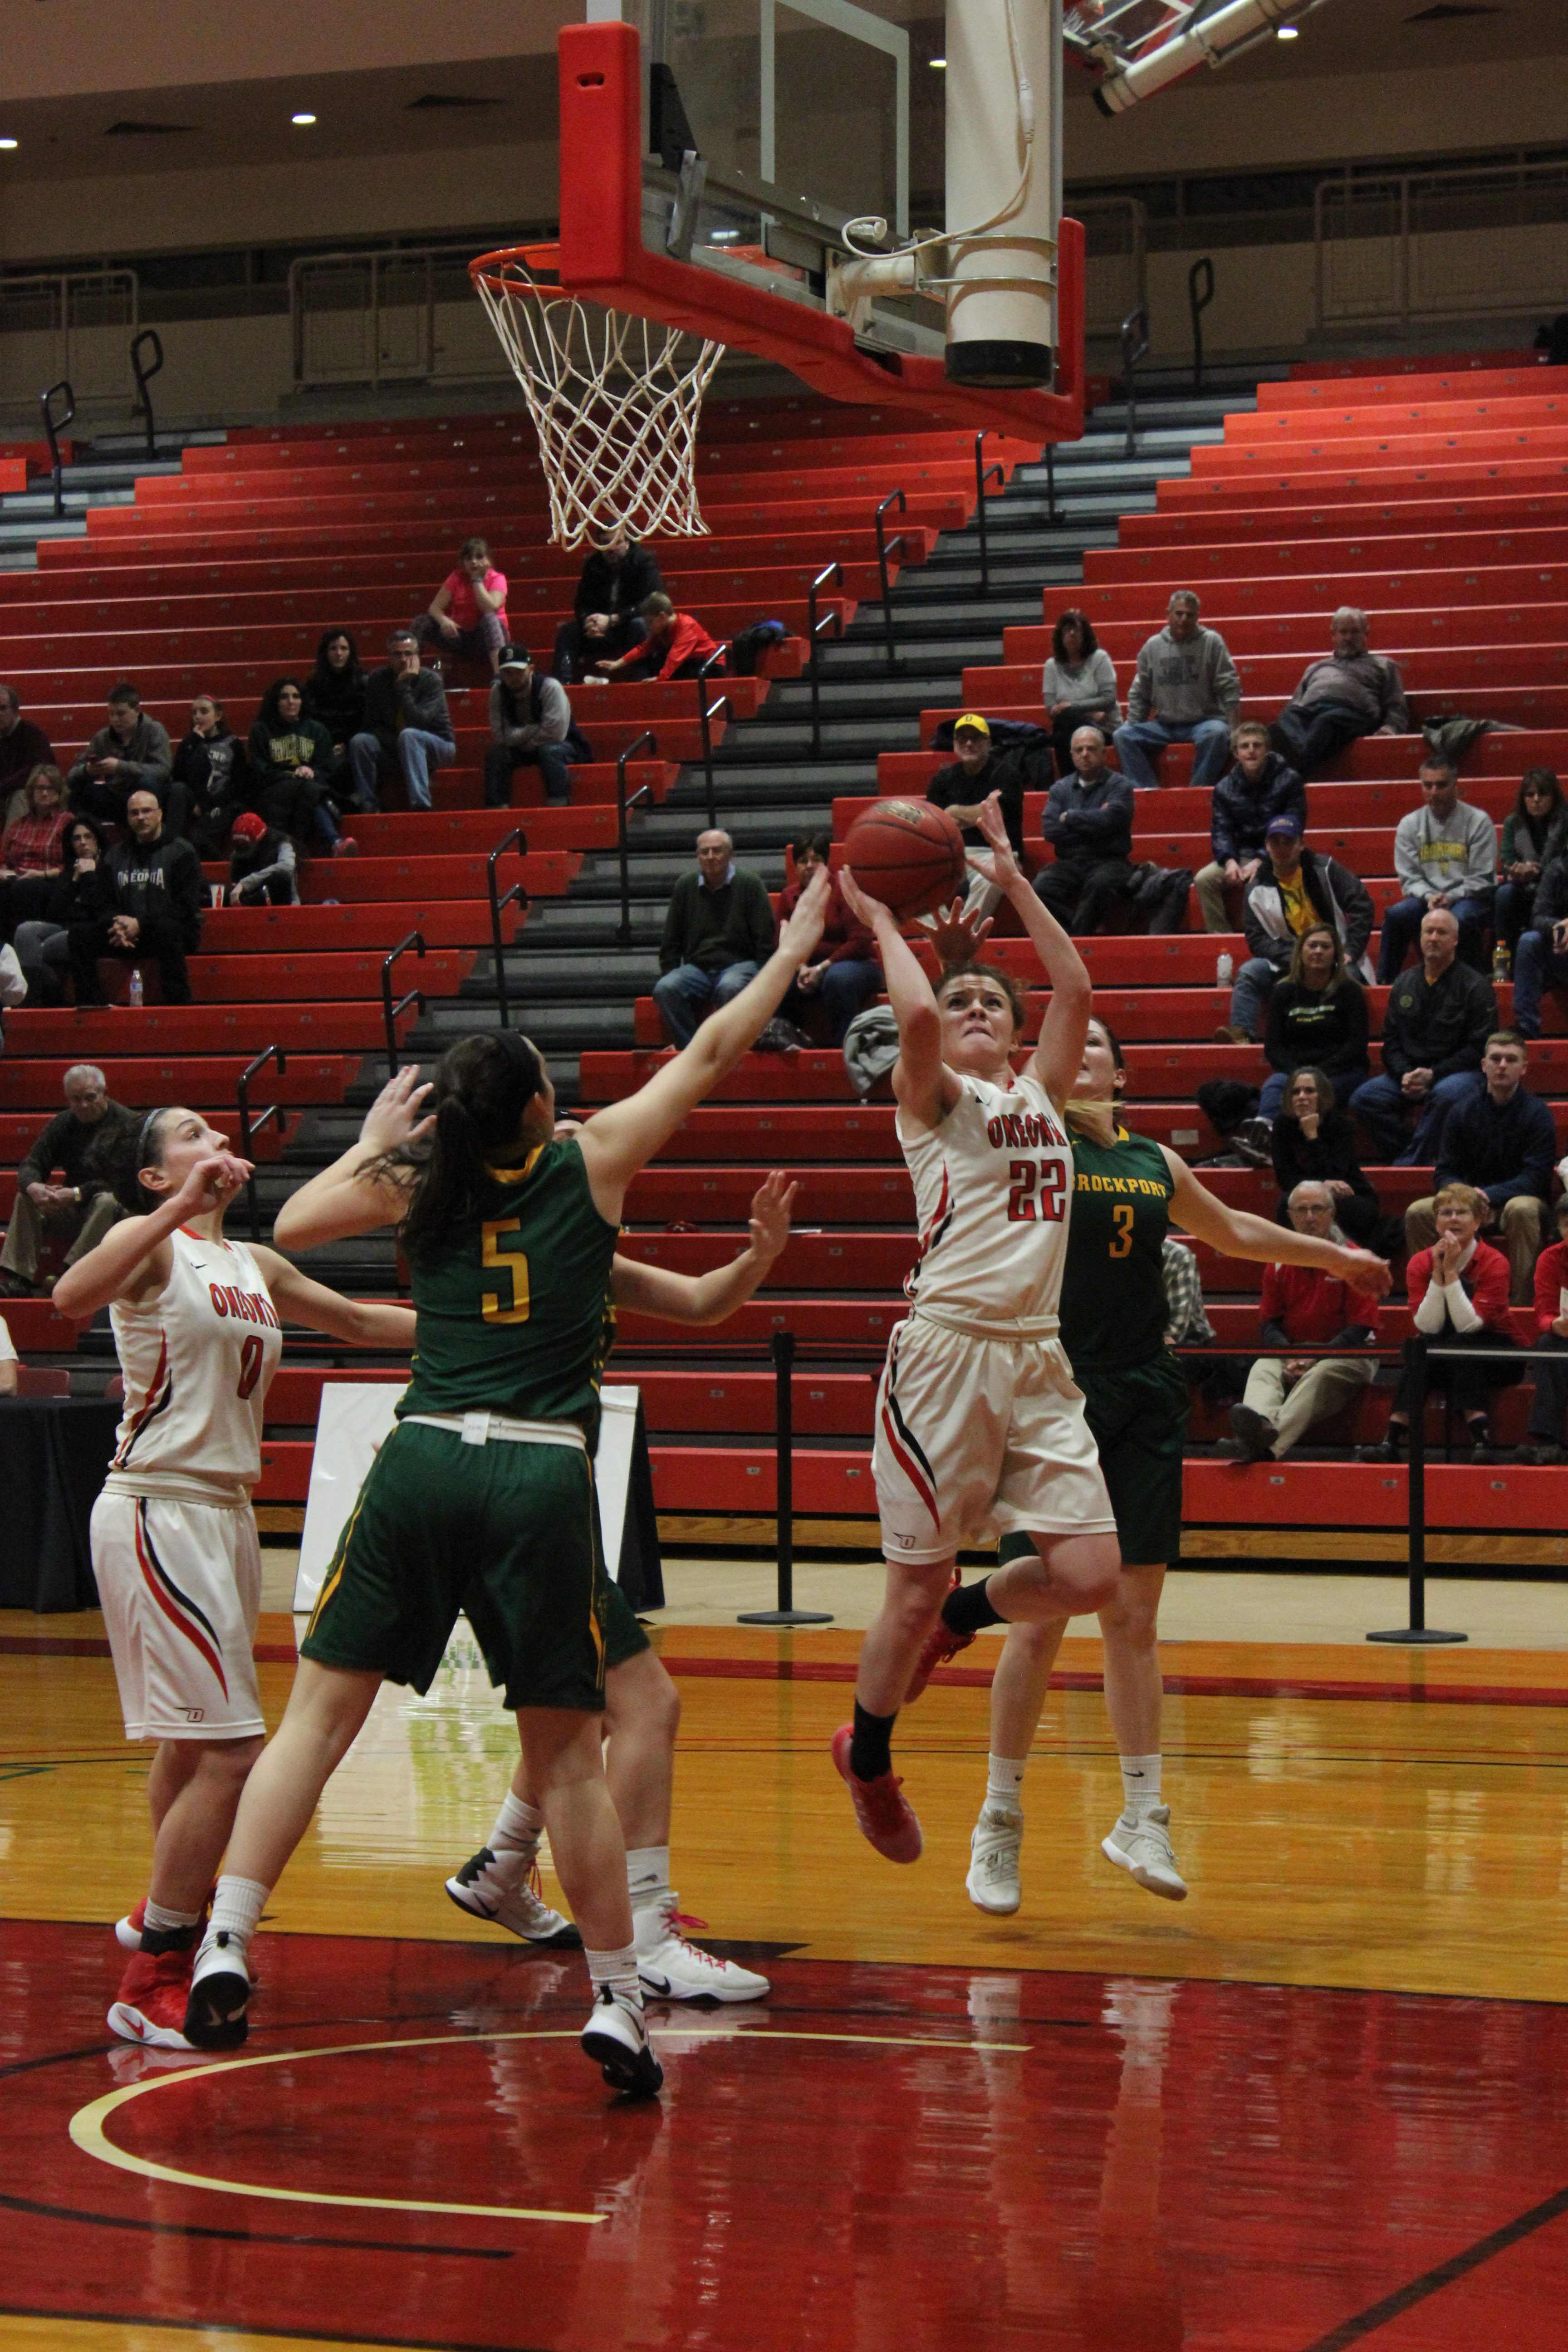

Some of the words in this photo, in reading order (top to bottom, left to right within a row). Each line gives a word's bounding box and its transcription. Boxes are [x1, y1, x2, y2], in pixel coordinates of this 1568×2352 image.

[1008, 1159, 1066, 1223] 22
[1109, 1205, 1134, 1258] 3
[482, 1217, 530, 1324] 5
[237, 1335, 264, 1400] 0
